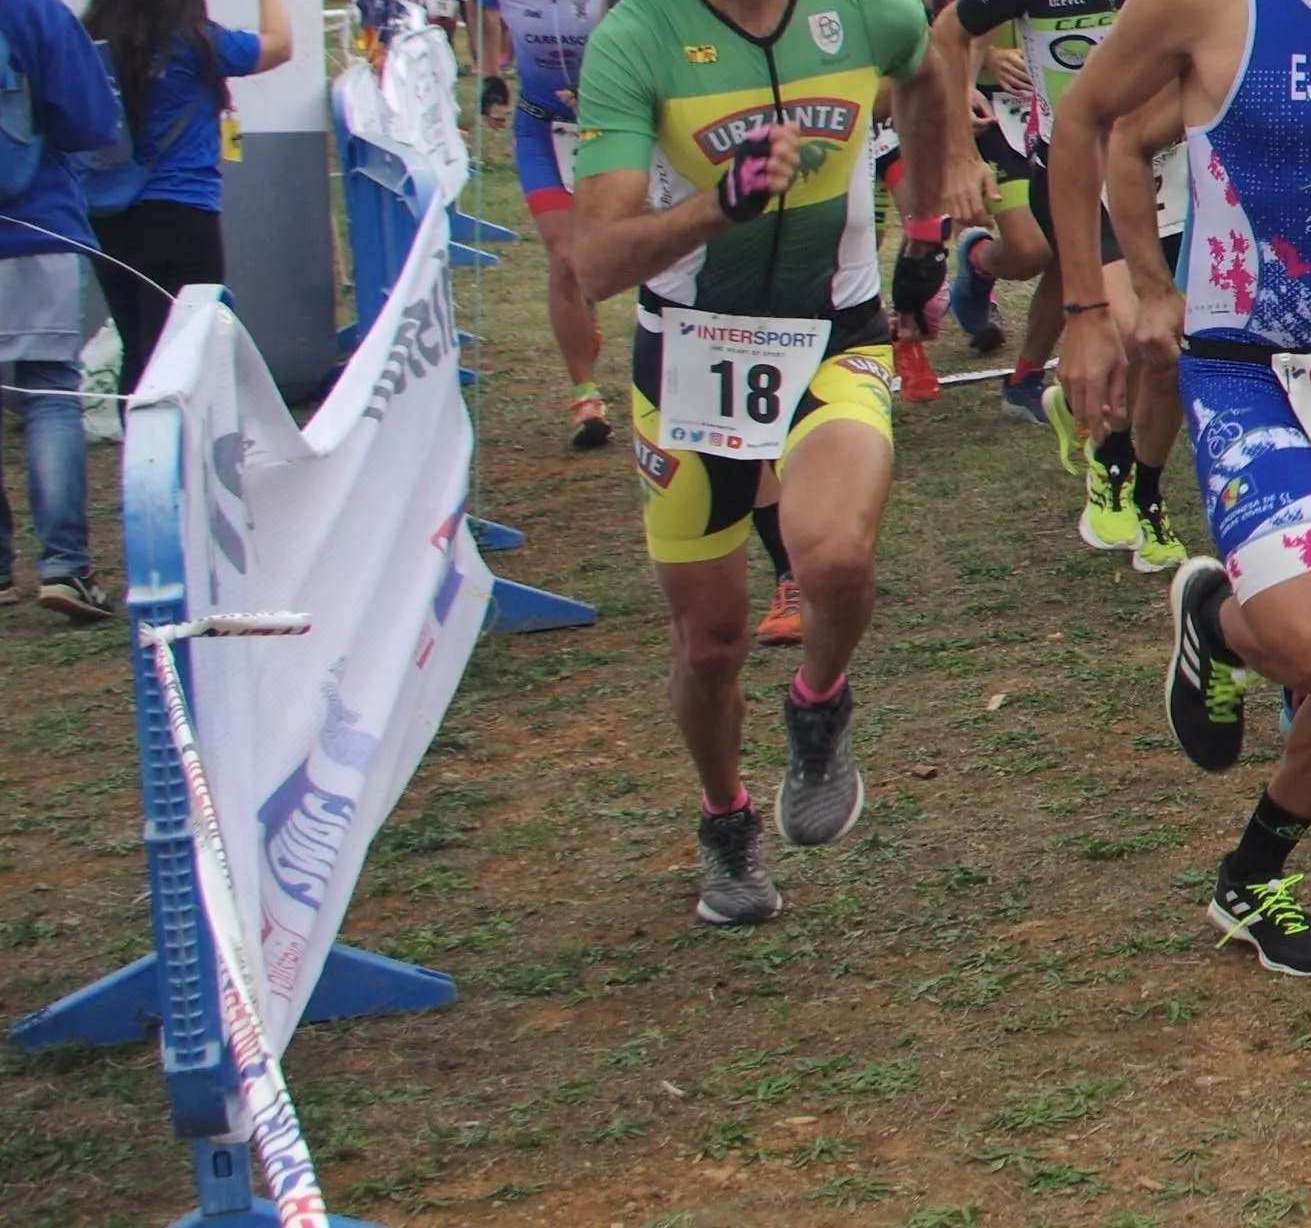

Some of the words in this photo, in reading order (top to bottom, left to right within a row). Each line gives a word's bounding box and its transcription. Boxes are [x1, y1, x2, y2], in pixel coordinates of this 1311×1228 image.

[525, 34, 588, 46] CARRASC
[698, 325, 818, 348] INTERSPORT
[710, 359, 782, 424] 18
